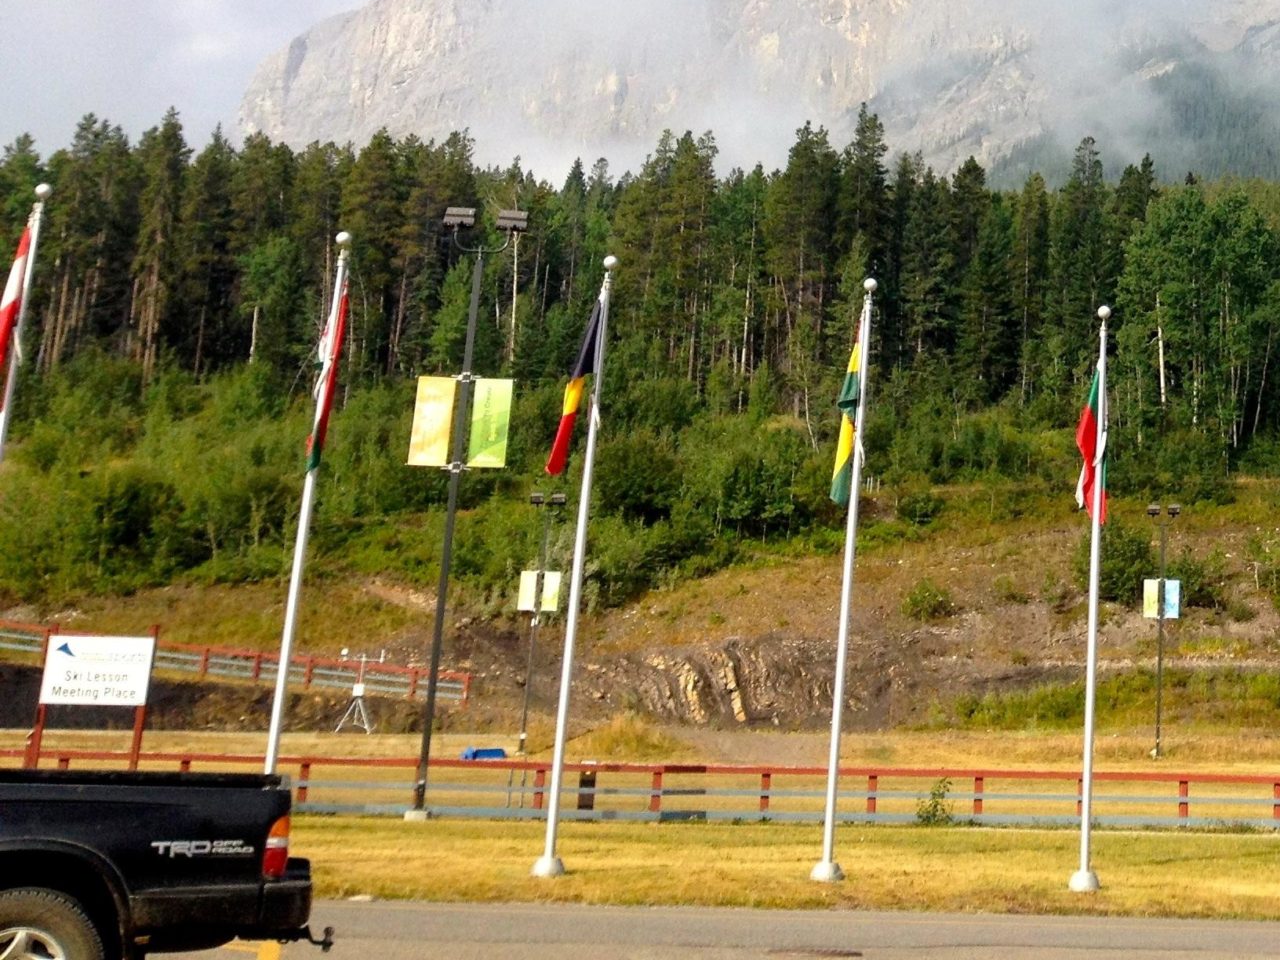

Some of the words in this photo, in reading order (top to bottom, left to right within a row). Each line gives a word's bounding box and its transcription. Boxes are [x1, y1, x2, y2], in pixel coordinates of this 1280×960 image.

[65, 670, 82, 681] Ski
[87, 671, 128, 682] Lesson
[52, 686, 99, 700] Meeting
[104, 687, 136, 699] Place
[151, 840, 211, 857] TRD
